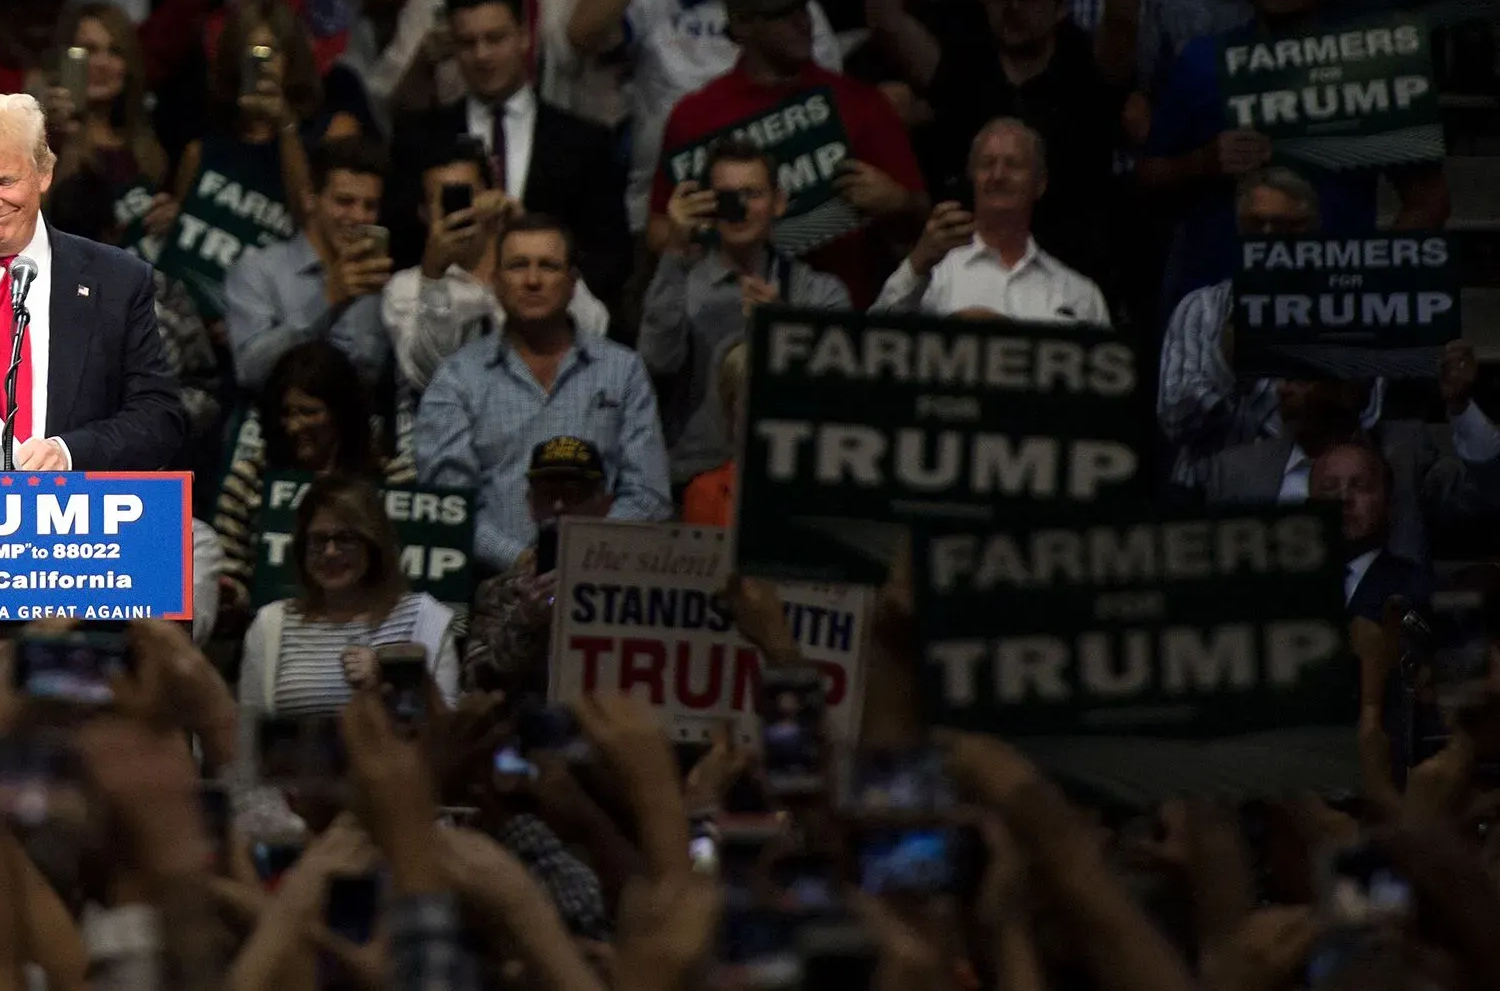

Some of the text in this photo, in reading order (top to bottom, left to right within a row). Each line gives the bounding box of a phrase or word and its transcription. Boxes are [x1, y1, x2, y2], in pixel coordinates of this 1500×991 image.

[1225, 25, 1420, 78] FARMERS
[1227, 74, 1430, 127] TRUMP
[1241, 236, 1450, 272] FARMERS
[1238, 291, 1454, 328] TRUMP
[767, 321, 1141, 397] FARMERS
[754, 418, 1141, 504] TRUMP
[32, 547, 49, 559] to
[53, 543, 121, 559] 88022
[928, 515, 1329, 596] FARMERS
[18, 606, 77, 619] GREAT
[85, 606, 151, 619] AGAIN!
[572, 583, 853, 653] STANDS ITH
[925, 618, 1342, 707] TRUMP
